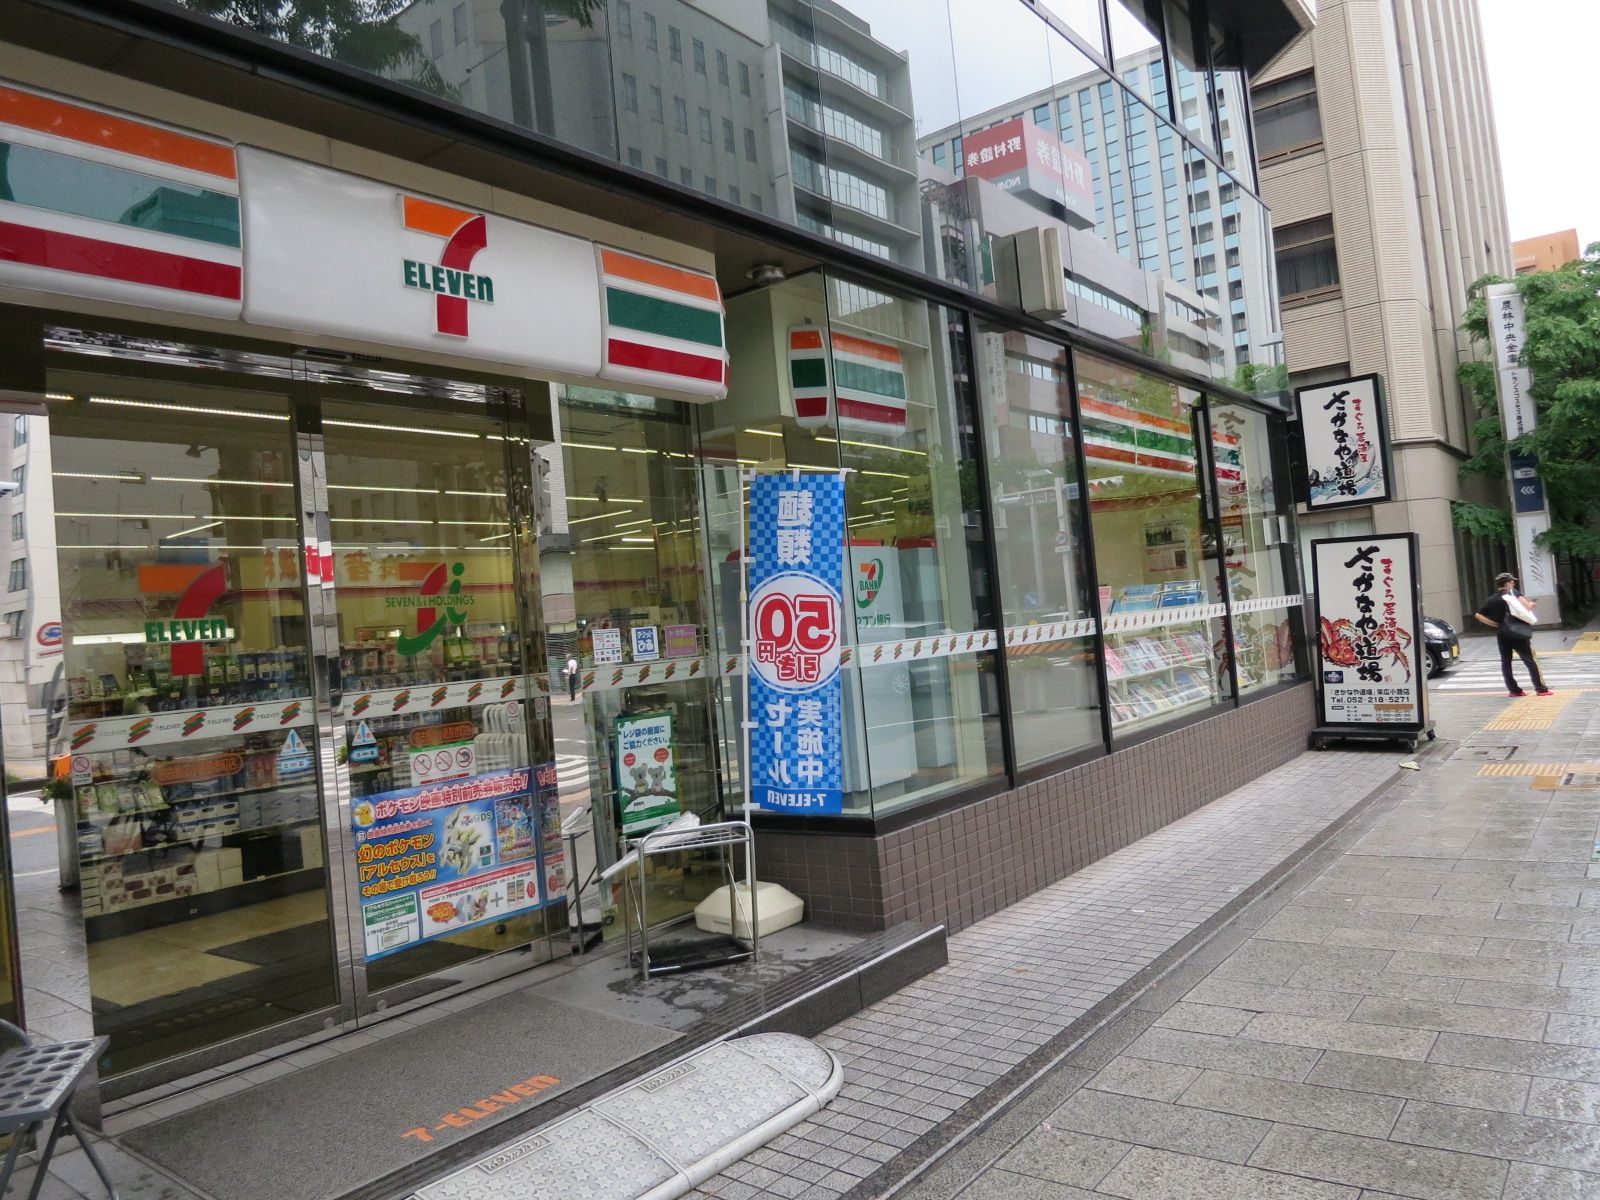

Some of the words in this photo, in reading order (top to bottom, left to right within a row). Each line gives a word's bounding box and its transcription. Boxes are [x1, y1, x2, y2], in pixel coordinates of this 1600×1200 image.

[1511, 372, 1524, 435] トランスコスモス株式会
[1323, 390, 1357, 496] さかなや道場
[428, 595, 475, 607] HOLDINGS
[859, 580, 880, 591] BANK
[1344, 545, 1382, 683] さかなや道場
[358, 833, 435, 863] 幻のポケモン
